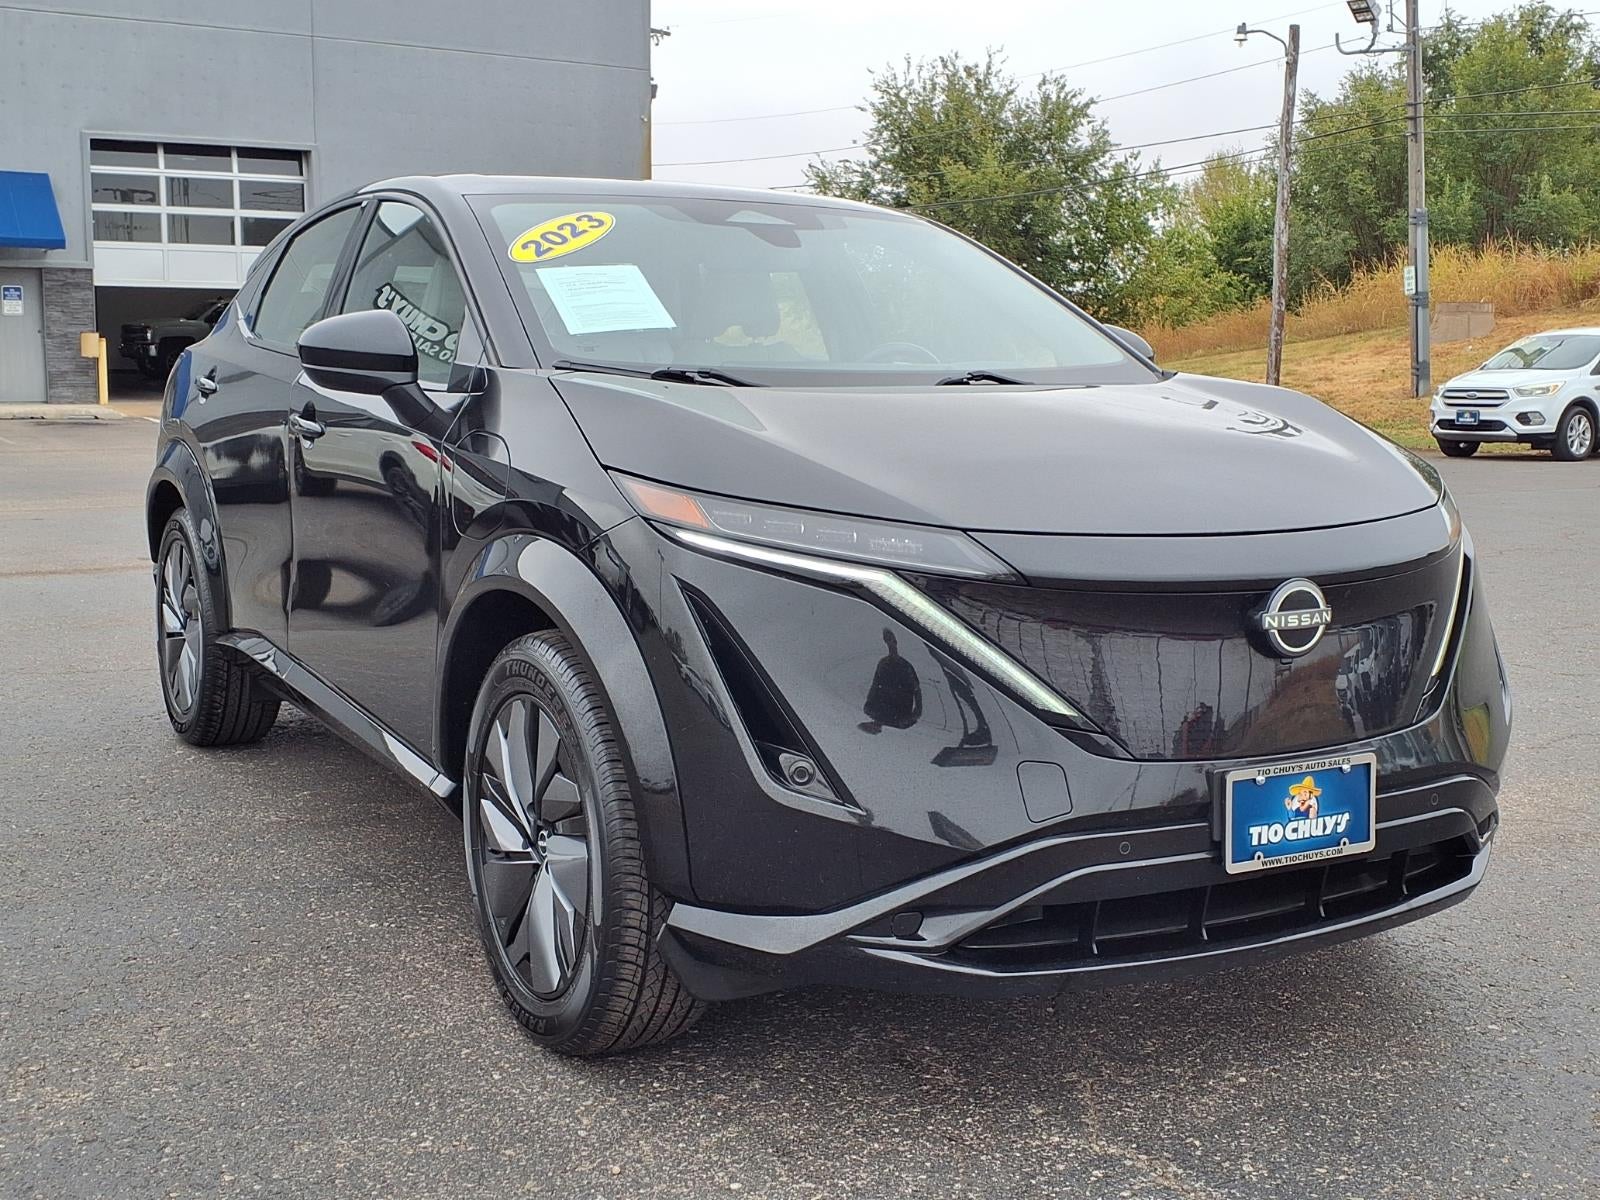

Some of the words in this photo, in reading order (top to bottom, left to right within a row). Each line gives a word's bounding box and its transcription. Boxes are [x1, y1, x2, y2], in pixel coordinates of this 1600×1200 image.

[521, 214, 605, 257] 2023
[1264, 610, 1332, 628] NISSAN
[1256, 768, 1271, 776] TIO
[1273, 764, 1303, 775] CHUY'S
[1305, 761, 1326, 771] AUTO
[1328, 757, 1351, 768] SALES
[1260, 847, 1343, 867] WWW.TIOCHUYS.COM
